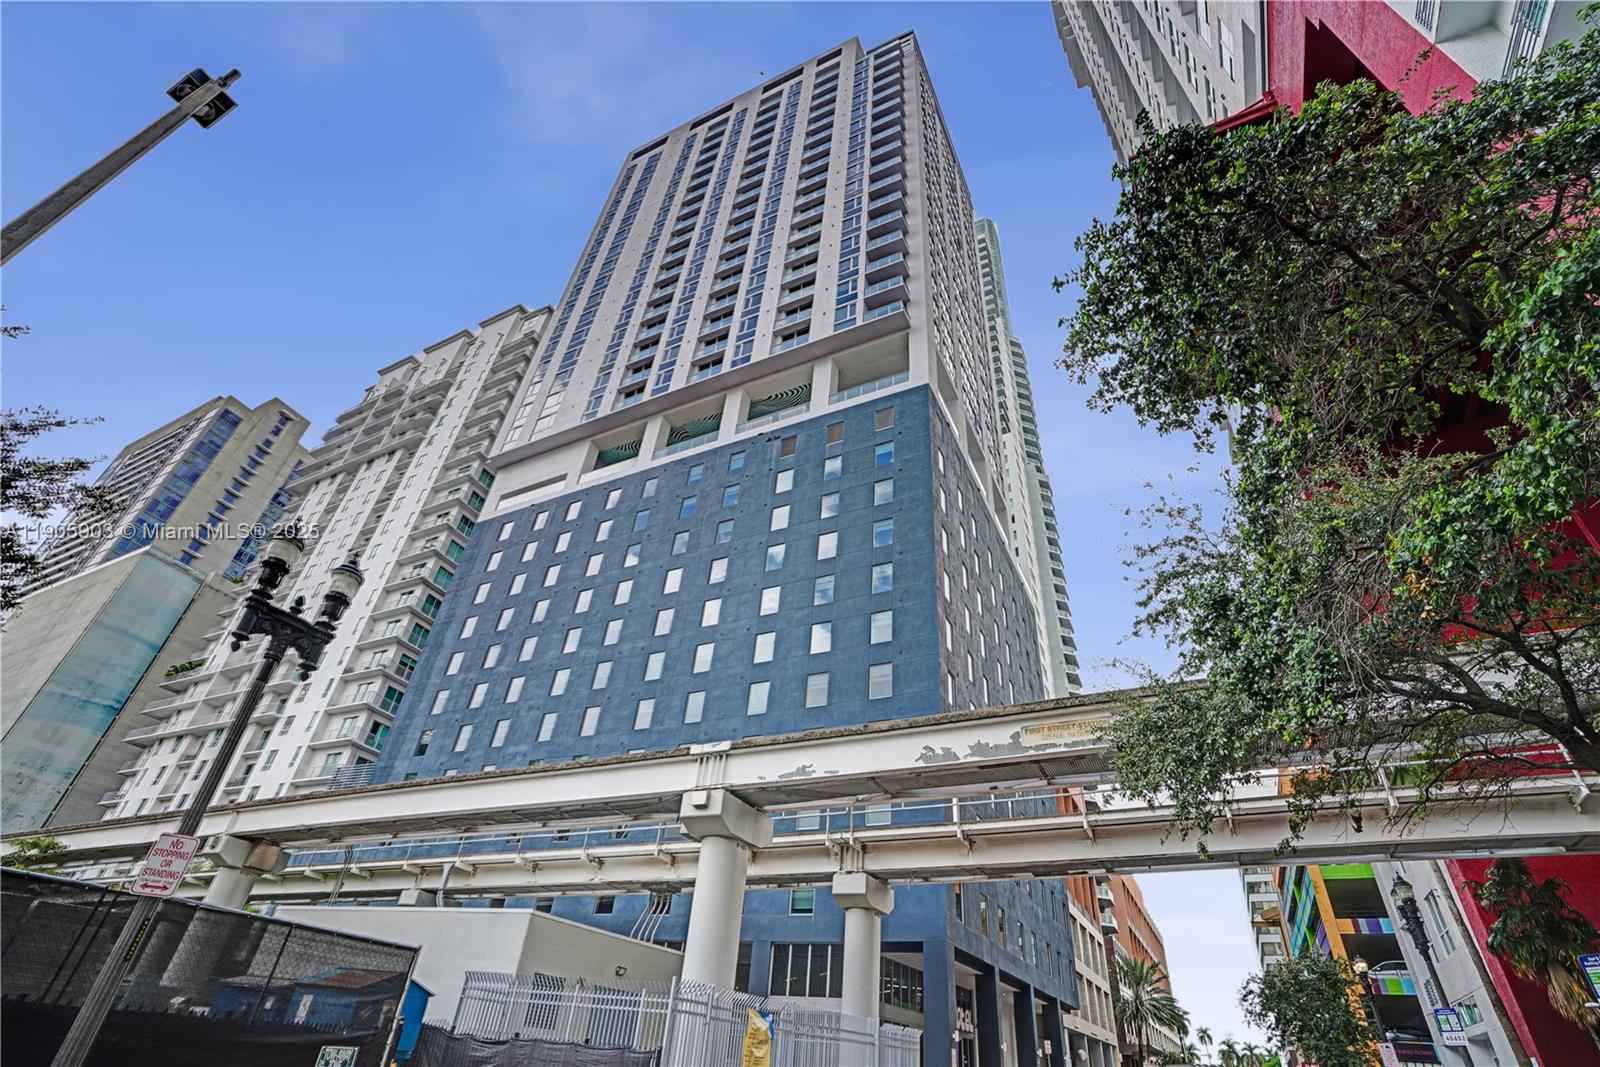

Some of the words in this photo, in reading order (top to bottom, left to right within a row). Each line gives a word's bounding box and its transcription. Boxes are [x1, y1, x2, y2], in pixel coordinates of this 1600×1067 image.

[1024, 726, 1046, 736] FIRST
[1047, 723, 1076, 733] STREET
[170, 839, 185, 850] NO
[152, 847, 190, 861] STOPPING
[160, 859, 173, 868] OR
[141, 867, 180, 880] STANDING
